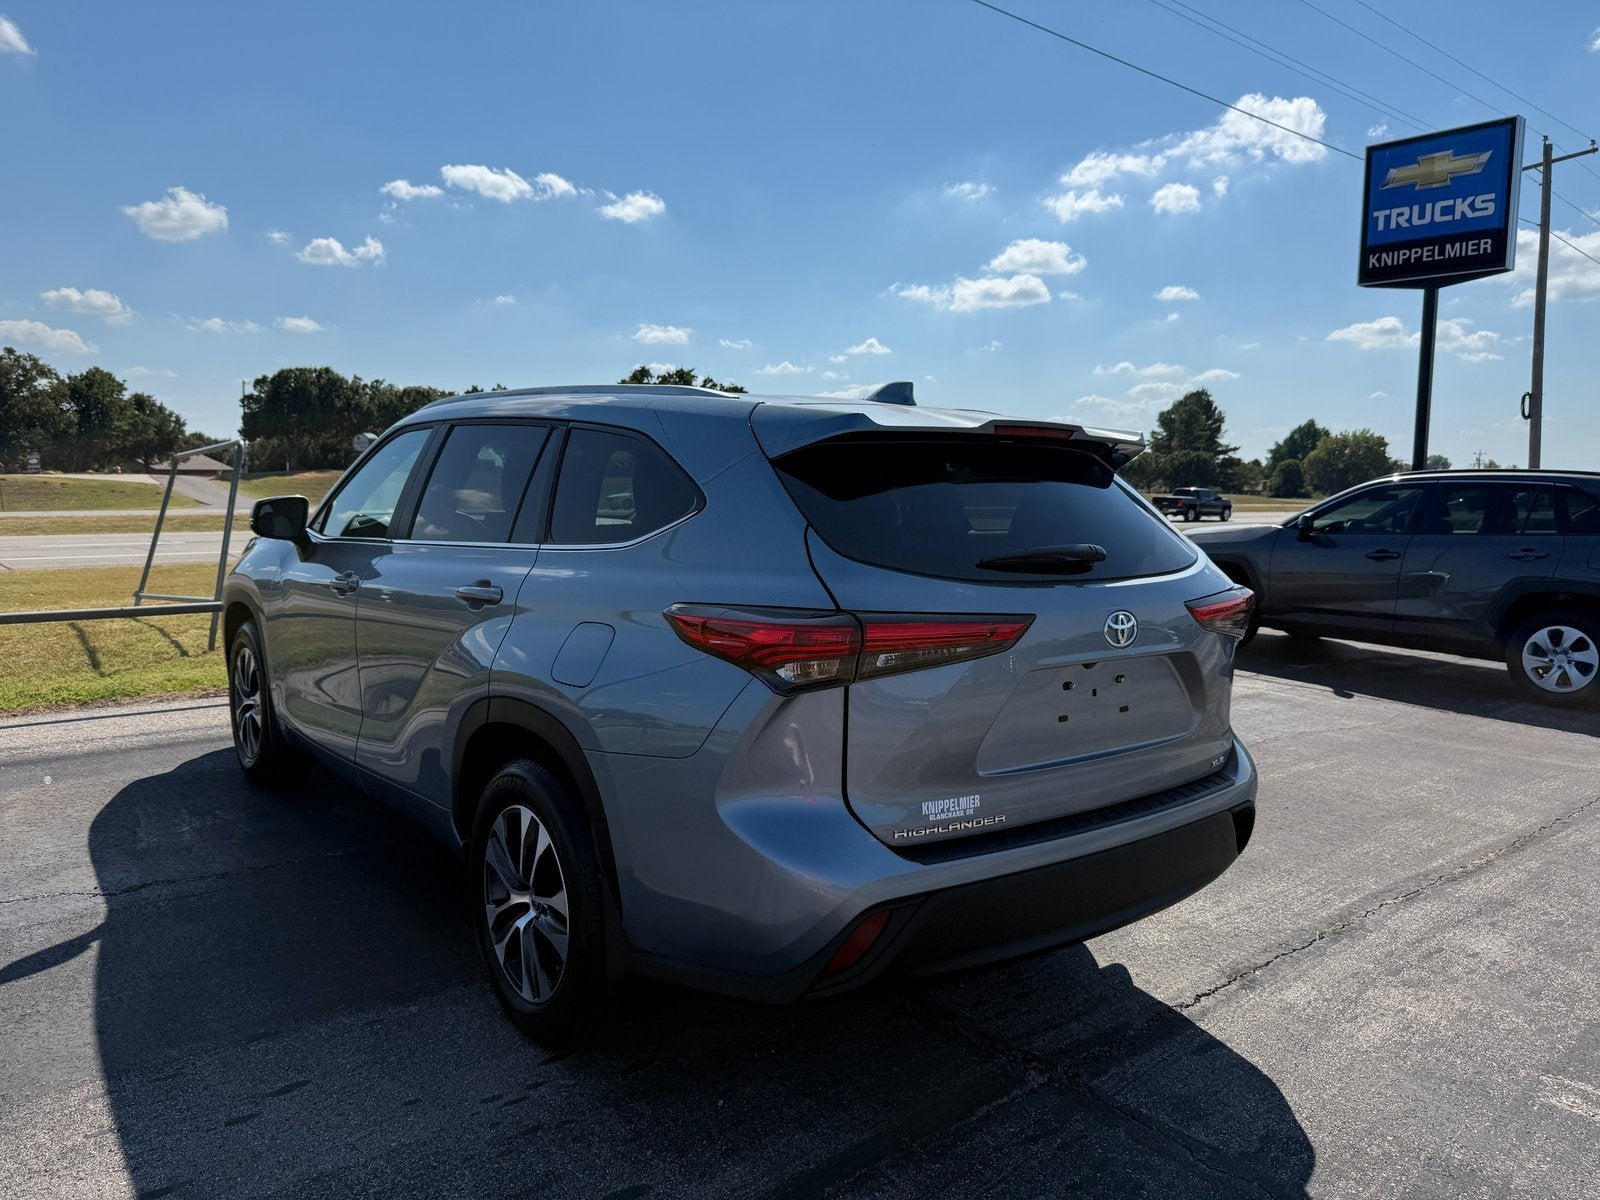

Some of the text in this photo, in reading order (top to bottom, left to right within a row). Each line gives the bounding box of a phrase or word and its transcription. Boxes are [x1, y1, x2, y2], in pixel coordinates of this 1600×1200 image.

[1373, 193, 1496, 231] TRUCKS
[1369, 238, 1492, 269] KNIPPELMIER
[922, 795, 980, 815] KNIPPELMIER
[894, 815, 1006, 839] HIGHLANDER
